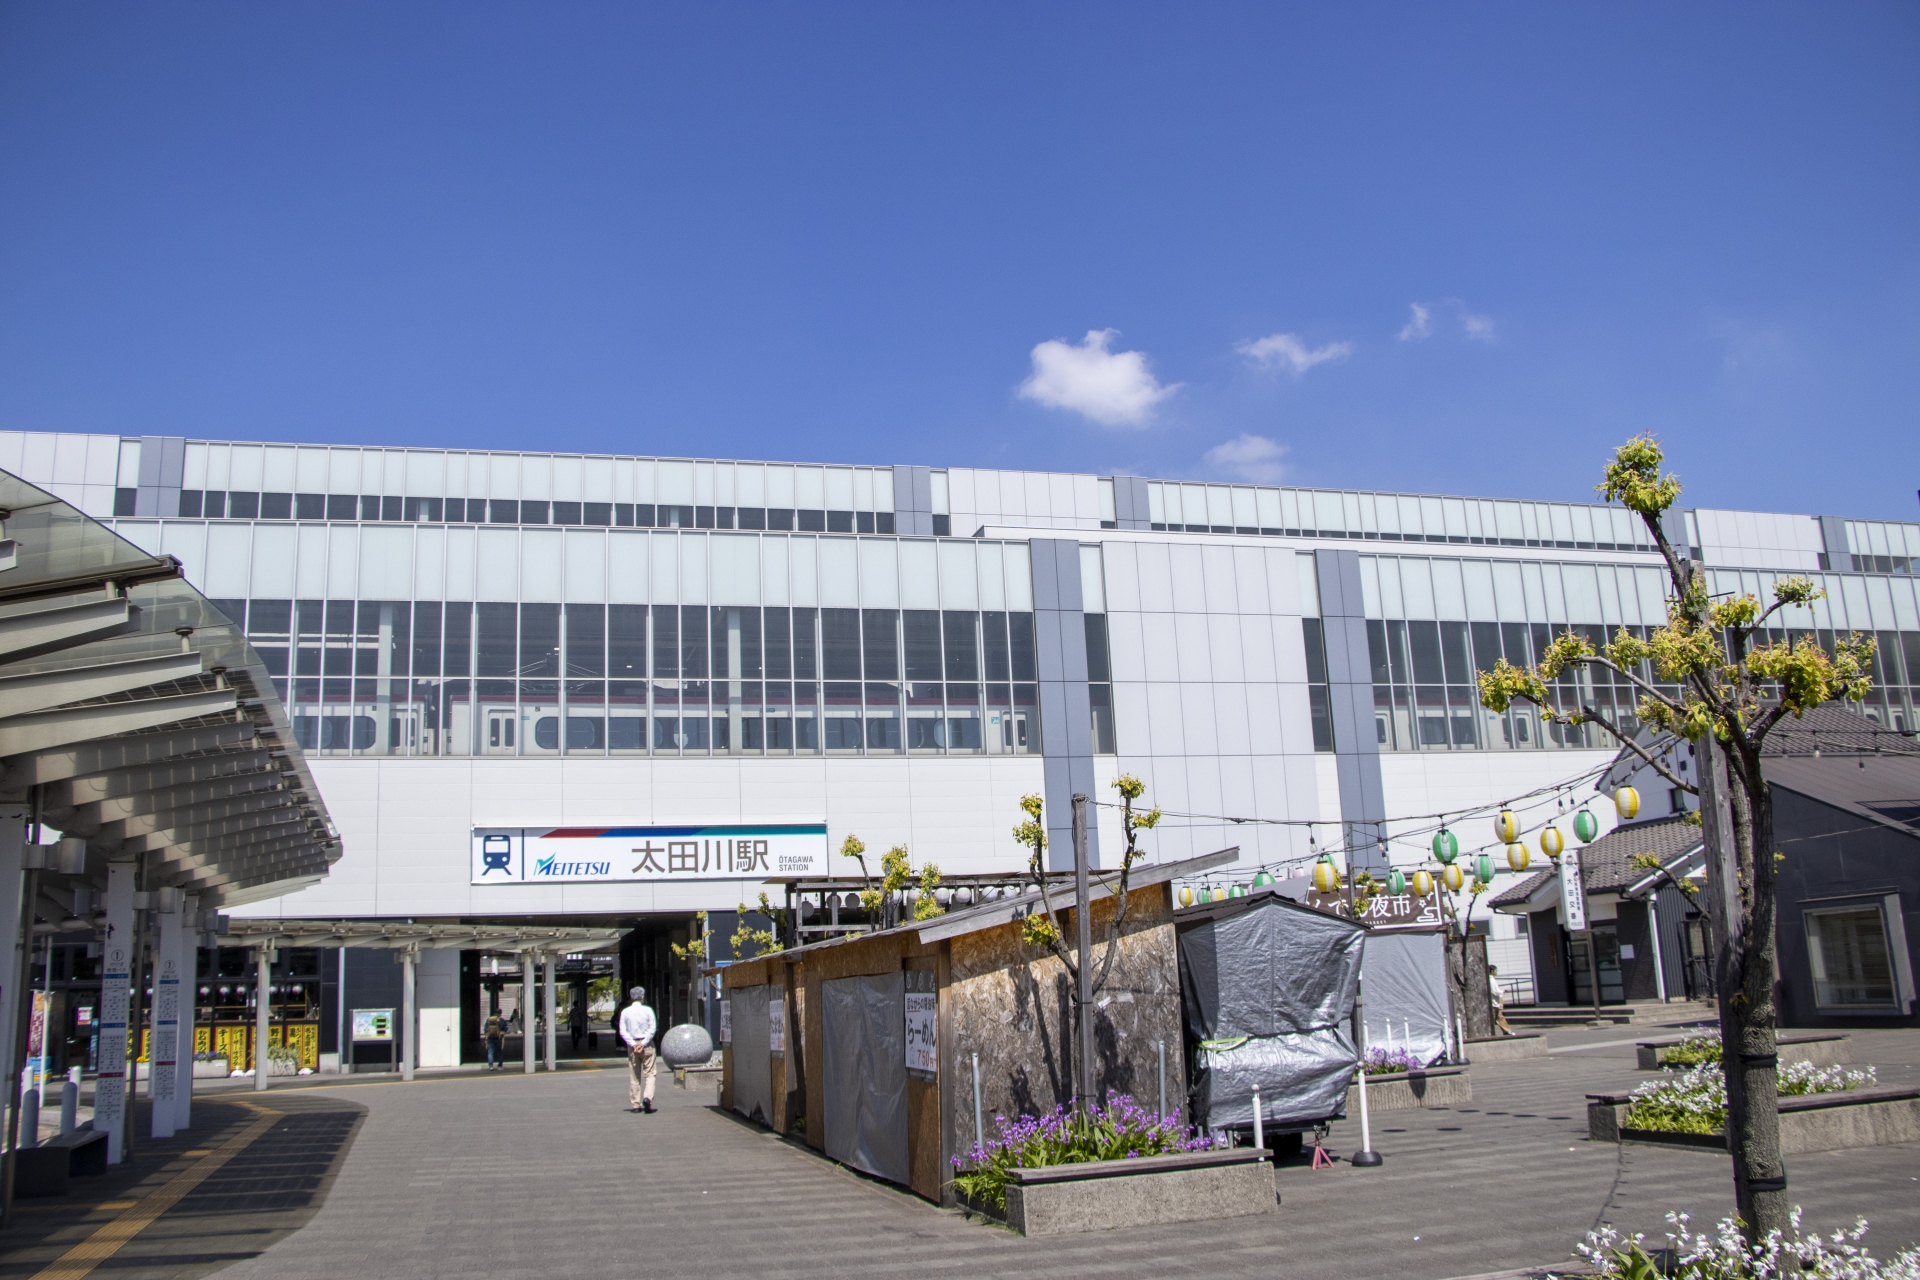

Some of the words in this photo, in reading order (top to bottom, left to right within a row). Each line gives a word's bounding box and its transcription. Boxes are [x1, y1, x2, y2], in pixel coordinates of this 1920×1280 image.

[534, 852, 610, 876] MEITETSU
[631, 839, 770, 874] 太田川駅
[778, 863, 809, 872] STATION
[907, 1018, 936, 1048] らーめん
